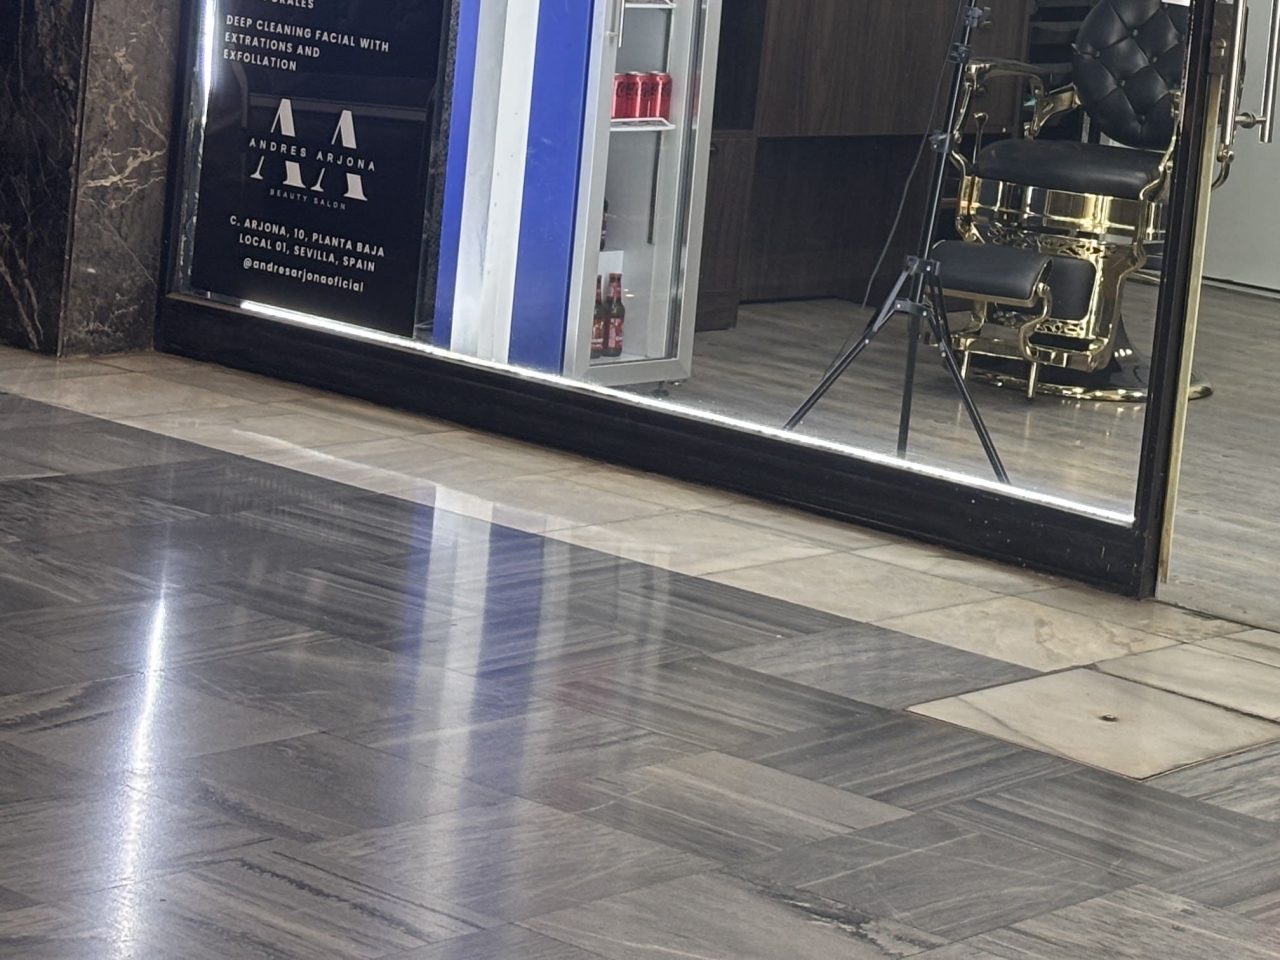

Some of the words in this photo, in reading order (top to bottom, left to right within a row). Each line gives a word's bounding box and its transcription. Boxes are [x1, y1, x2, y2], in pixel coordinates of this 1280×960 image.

[225, 32, 293, 53] EXTRATIONS
[297, 45, 320, 58] AND
[227, 14, 253, 28] DEEP
[256, 20, 312, 38] CLEANING
[316, 30, 355, 47] FACIAL
[360, 38, 389, 52] WITH
[224, 49, 297, 71] EXFOLLATION
[249, 138, 307, 157] ANDRES
[316, 151, 375, 172] ARJONA
[270, 189, 308, 202] BEAUTY
[314, 198, 346, 210] SALON
[230, 216, 241, 227] C.
[244, 218, 290, 237] ARJONA,
[294, 228, 308, 241] 10,
[312, 233, 353, 250] PLANTA
[356, 242, 385, 257] BAJA
[239, 234, 272, 250] LOCAL
[276, 242, 290, 255] 01,
[294, 246, 339, 265] SEVILLA,
[343, 256, 375, 272] SPAIN
[243, 257, 364, 292] @andresarjonaoficial
